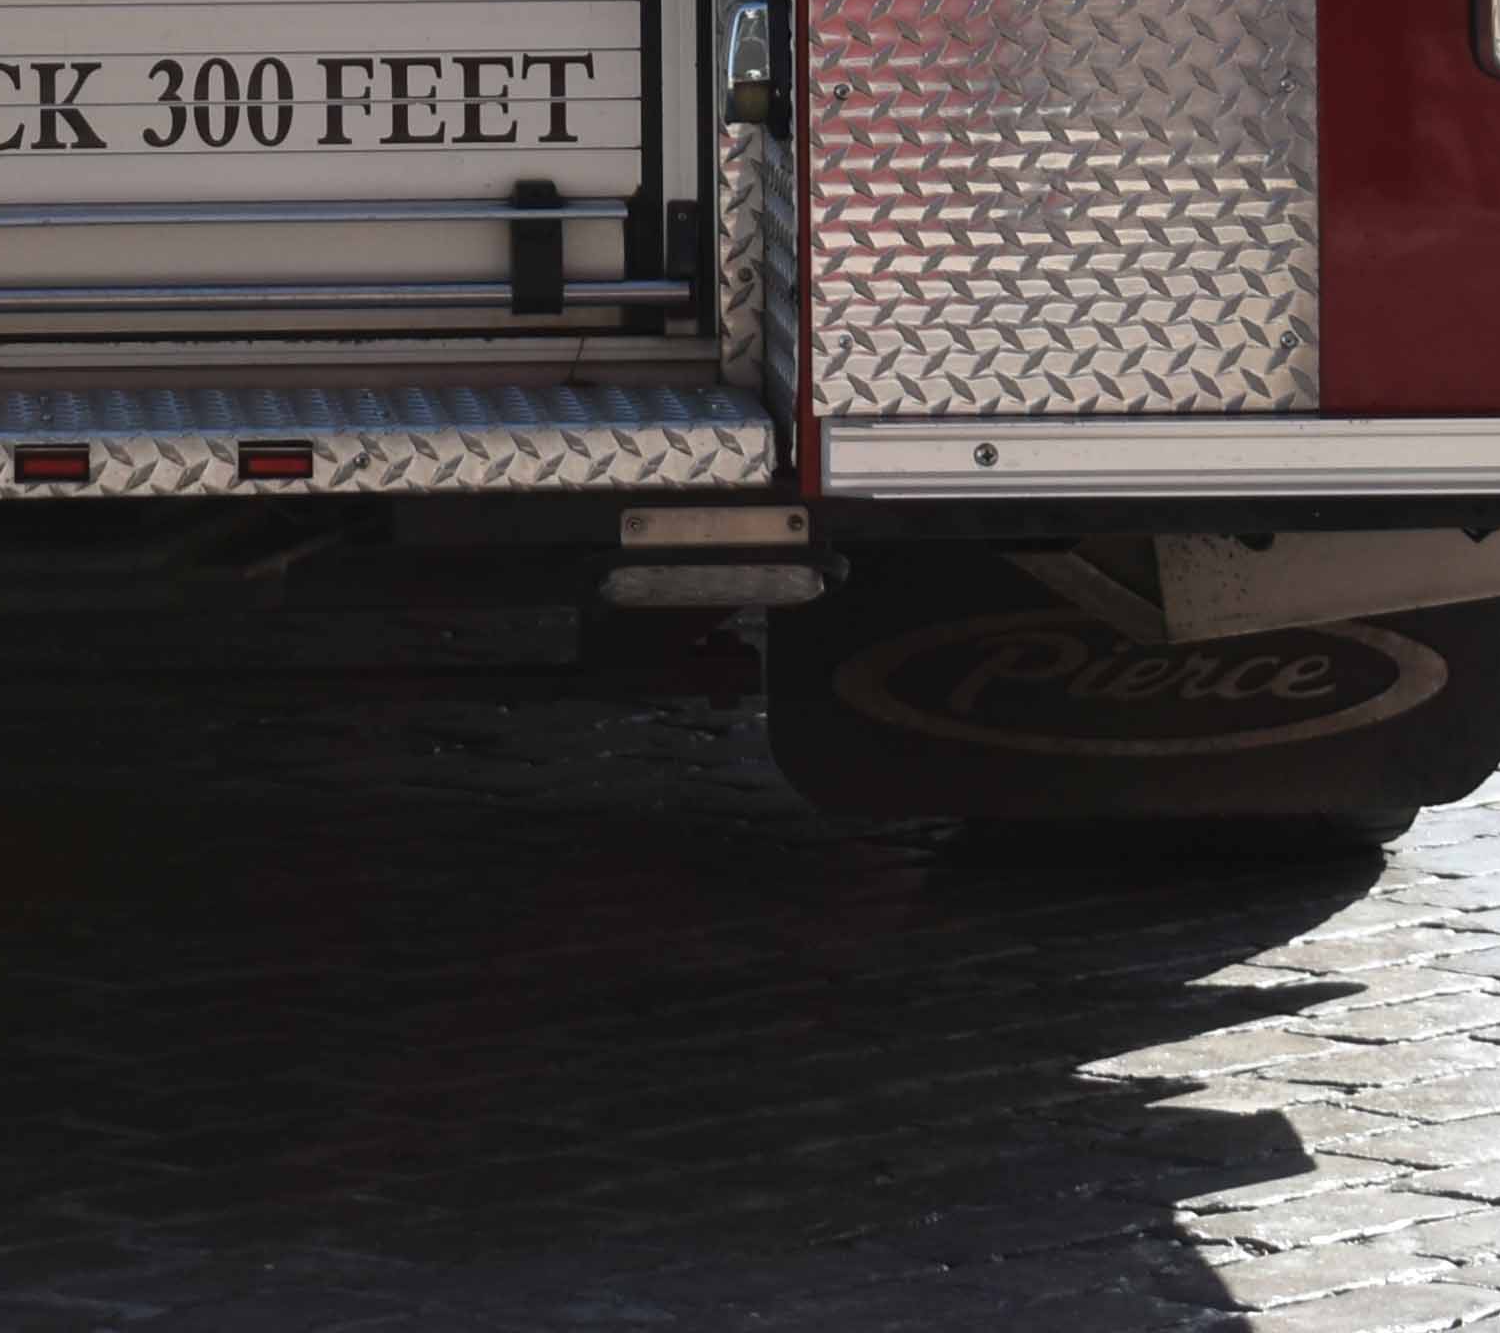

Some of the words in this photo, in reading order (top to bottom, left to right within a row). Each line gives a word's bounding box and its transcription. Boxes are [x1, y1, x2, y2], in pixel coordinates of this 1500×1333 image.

[142, 56, 295, 148] 300
[316, 51, 596, 147] FEET
[949, 632, 1336, 711] Pierce
